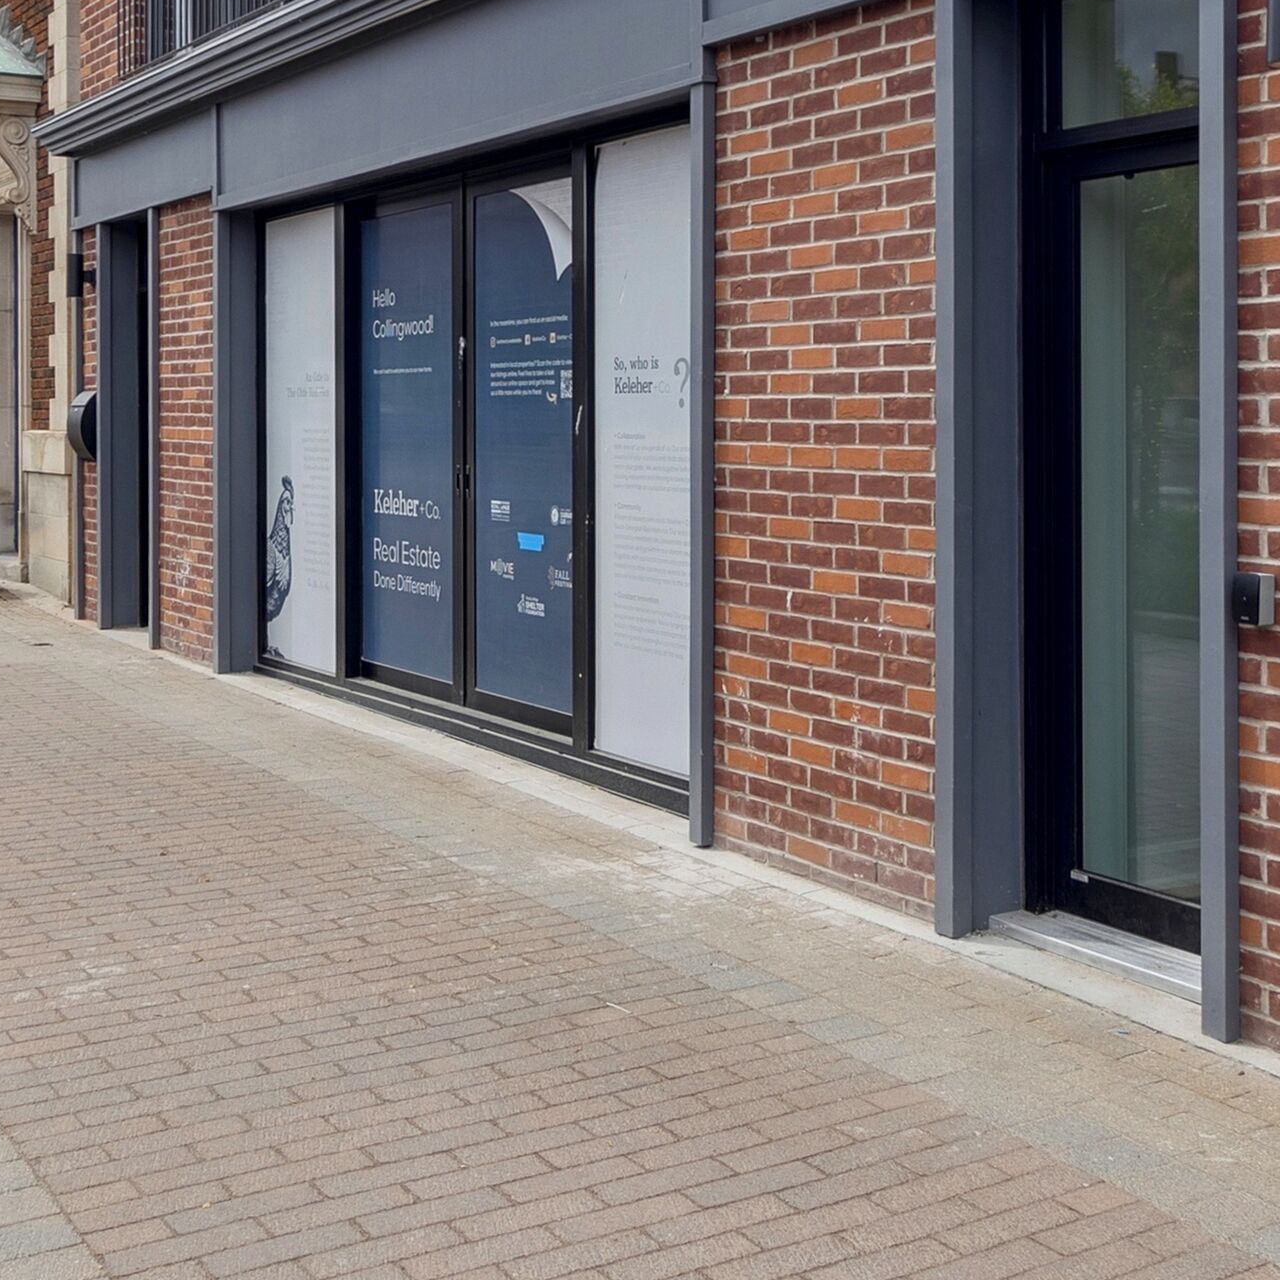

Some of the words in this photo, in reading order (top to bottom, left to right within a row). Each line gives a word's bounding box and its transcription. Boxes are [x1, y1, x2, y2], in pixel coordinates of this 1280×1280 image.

[372, 288, 396, 308] Hello
[372, 314, 434, 341] Collingwood!
[613, 356, 627, 373] So,
[629, 355, 649, 370] who
[650, 355, 660, 370] is
[614, 376, 653, 394] Keleher
[673, 357, 690, 408] ?
[373, 489, 419, 517] Keleher
[373, 537, 400, 563] Real
[401, 541, 441, 569] Estate
[373, 570, 397, 590] Done
[397, 574, 441, 602] Differently
